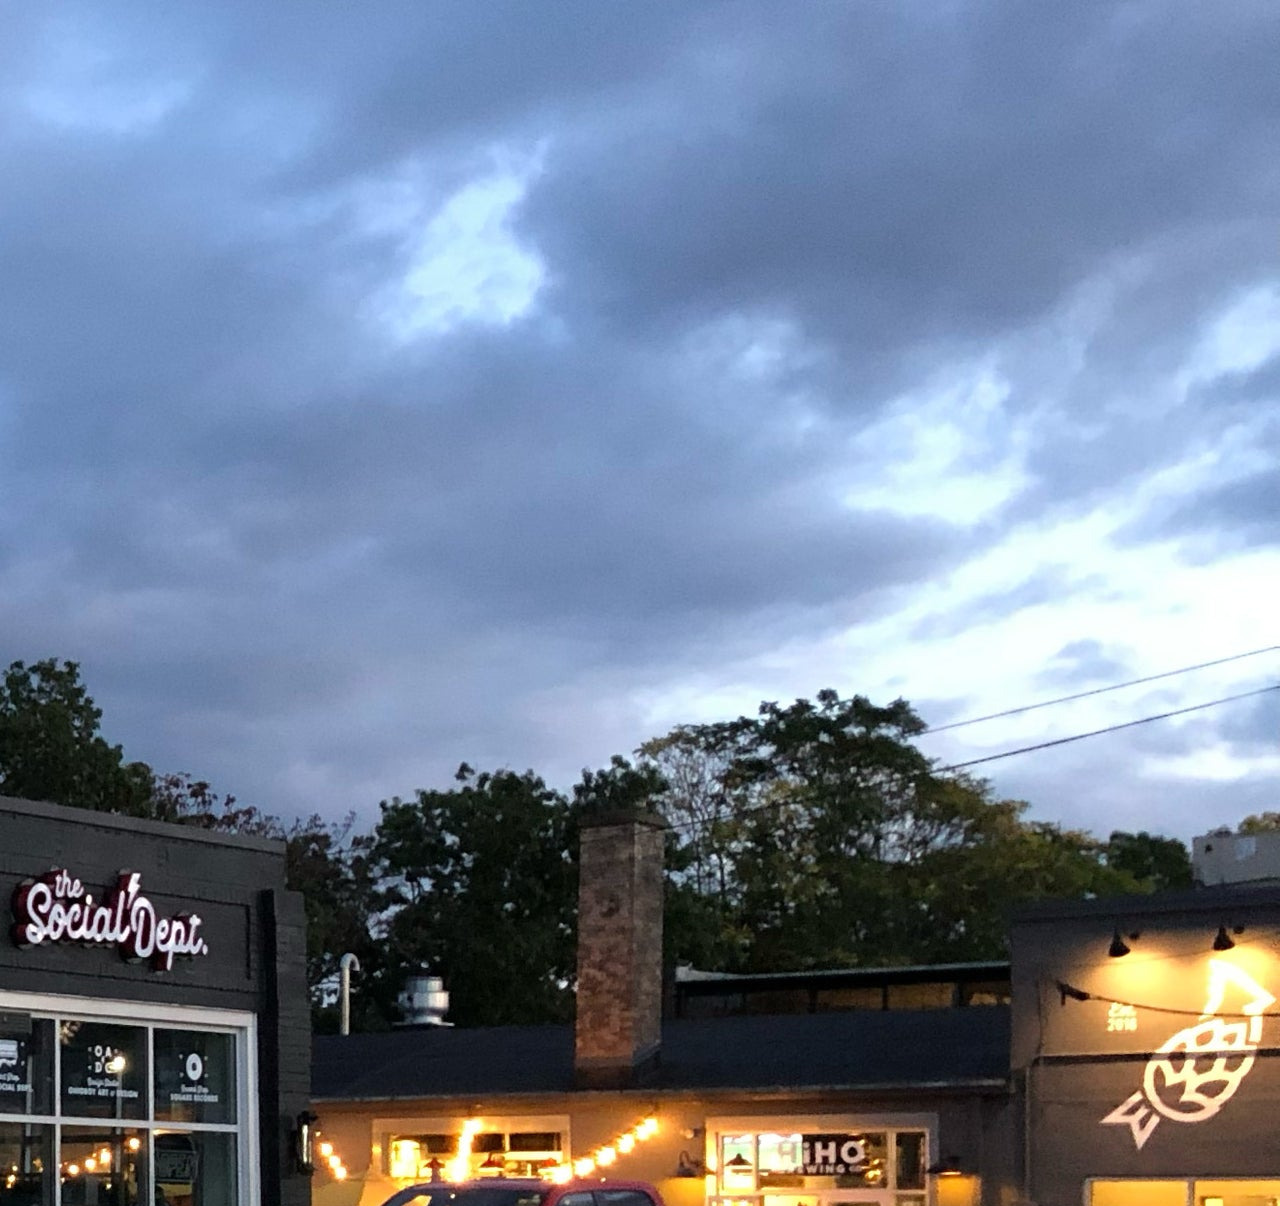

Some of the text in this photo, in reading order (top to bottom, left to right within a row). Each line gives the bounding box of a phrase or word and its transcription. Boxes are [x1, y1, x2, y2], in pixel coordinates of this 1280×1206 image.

[54, 869, 85, 898] the
[25, 882, 210, 970] Social Dept.
